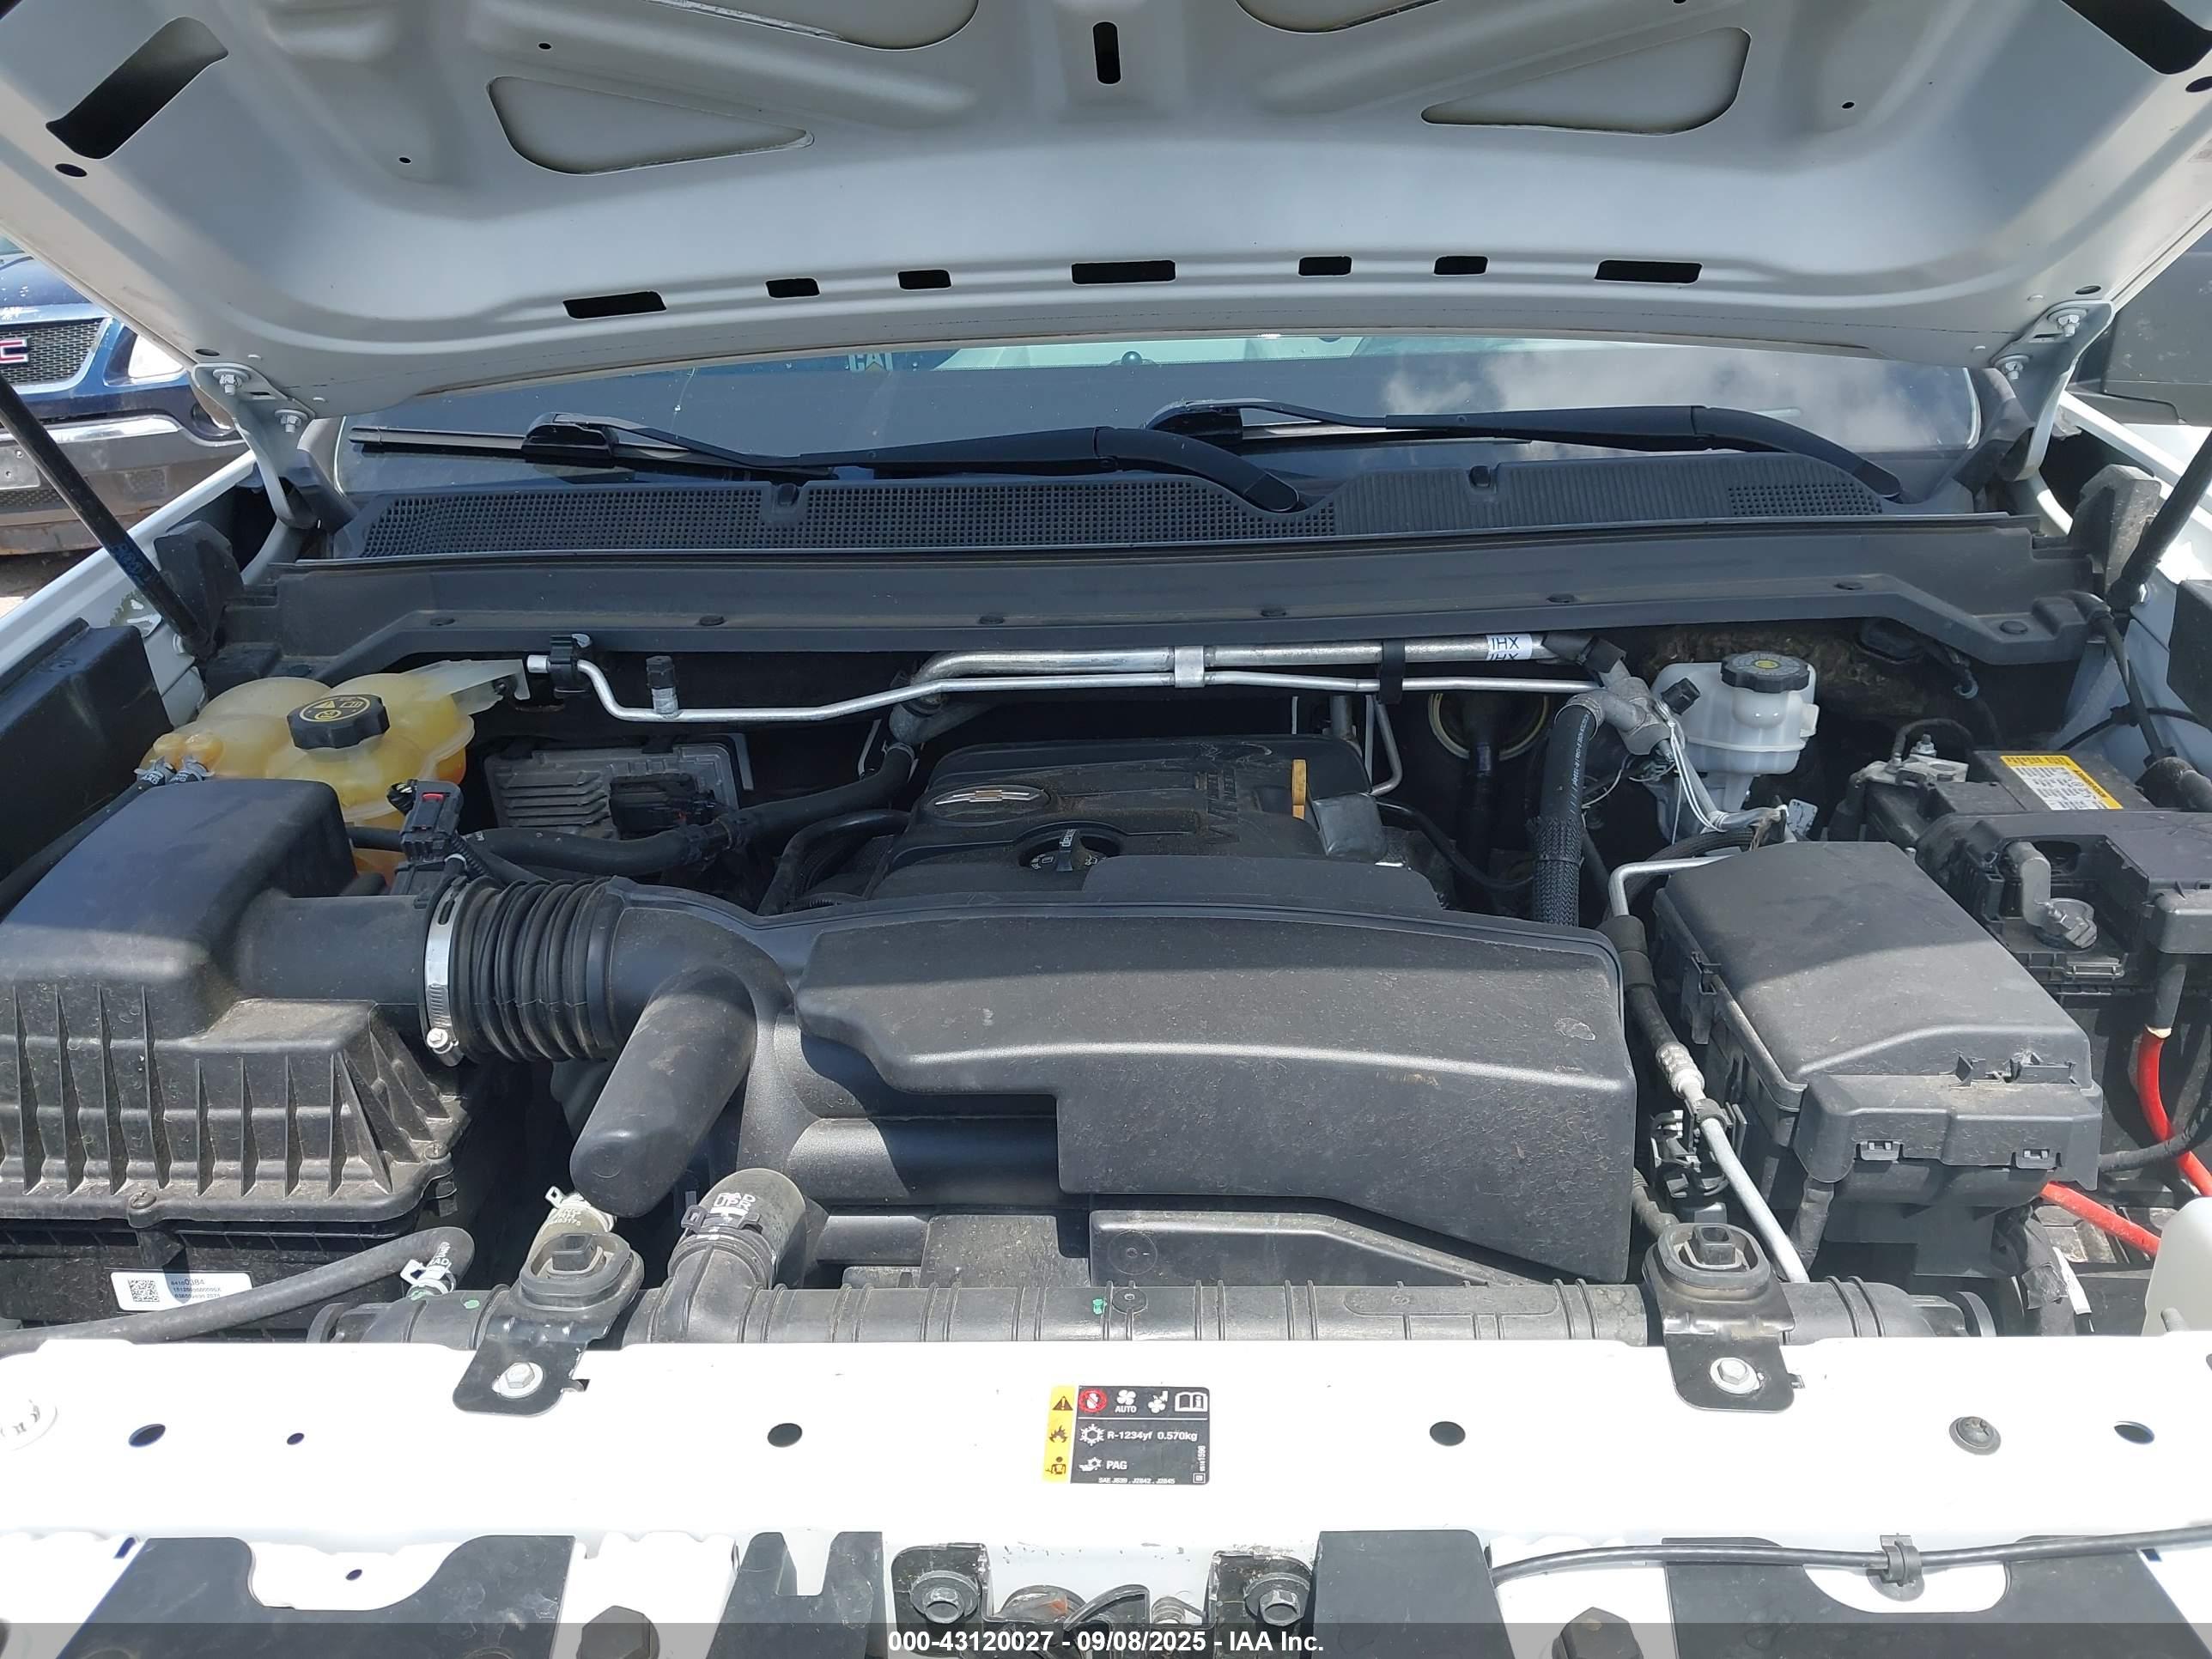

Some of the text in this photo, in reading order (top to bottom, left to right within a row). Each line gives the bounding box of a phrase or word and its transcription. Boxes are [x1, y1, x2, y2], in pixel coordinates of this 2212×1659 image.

[1115, 1405, 1137, 1413] AUTO
[1107, 1431, 1198, 1442] R-1234yf 0.570kg
[1106, 1460, 1127, 1470] PAG
